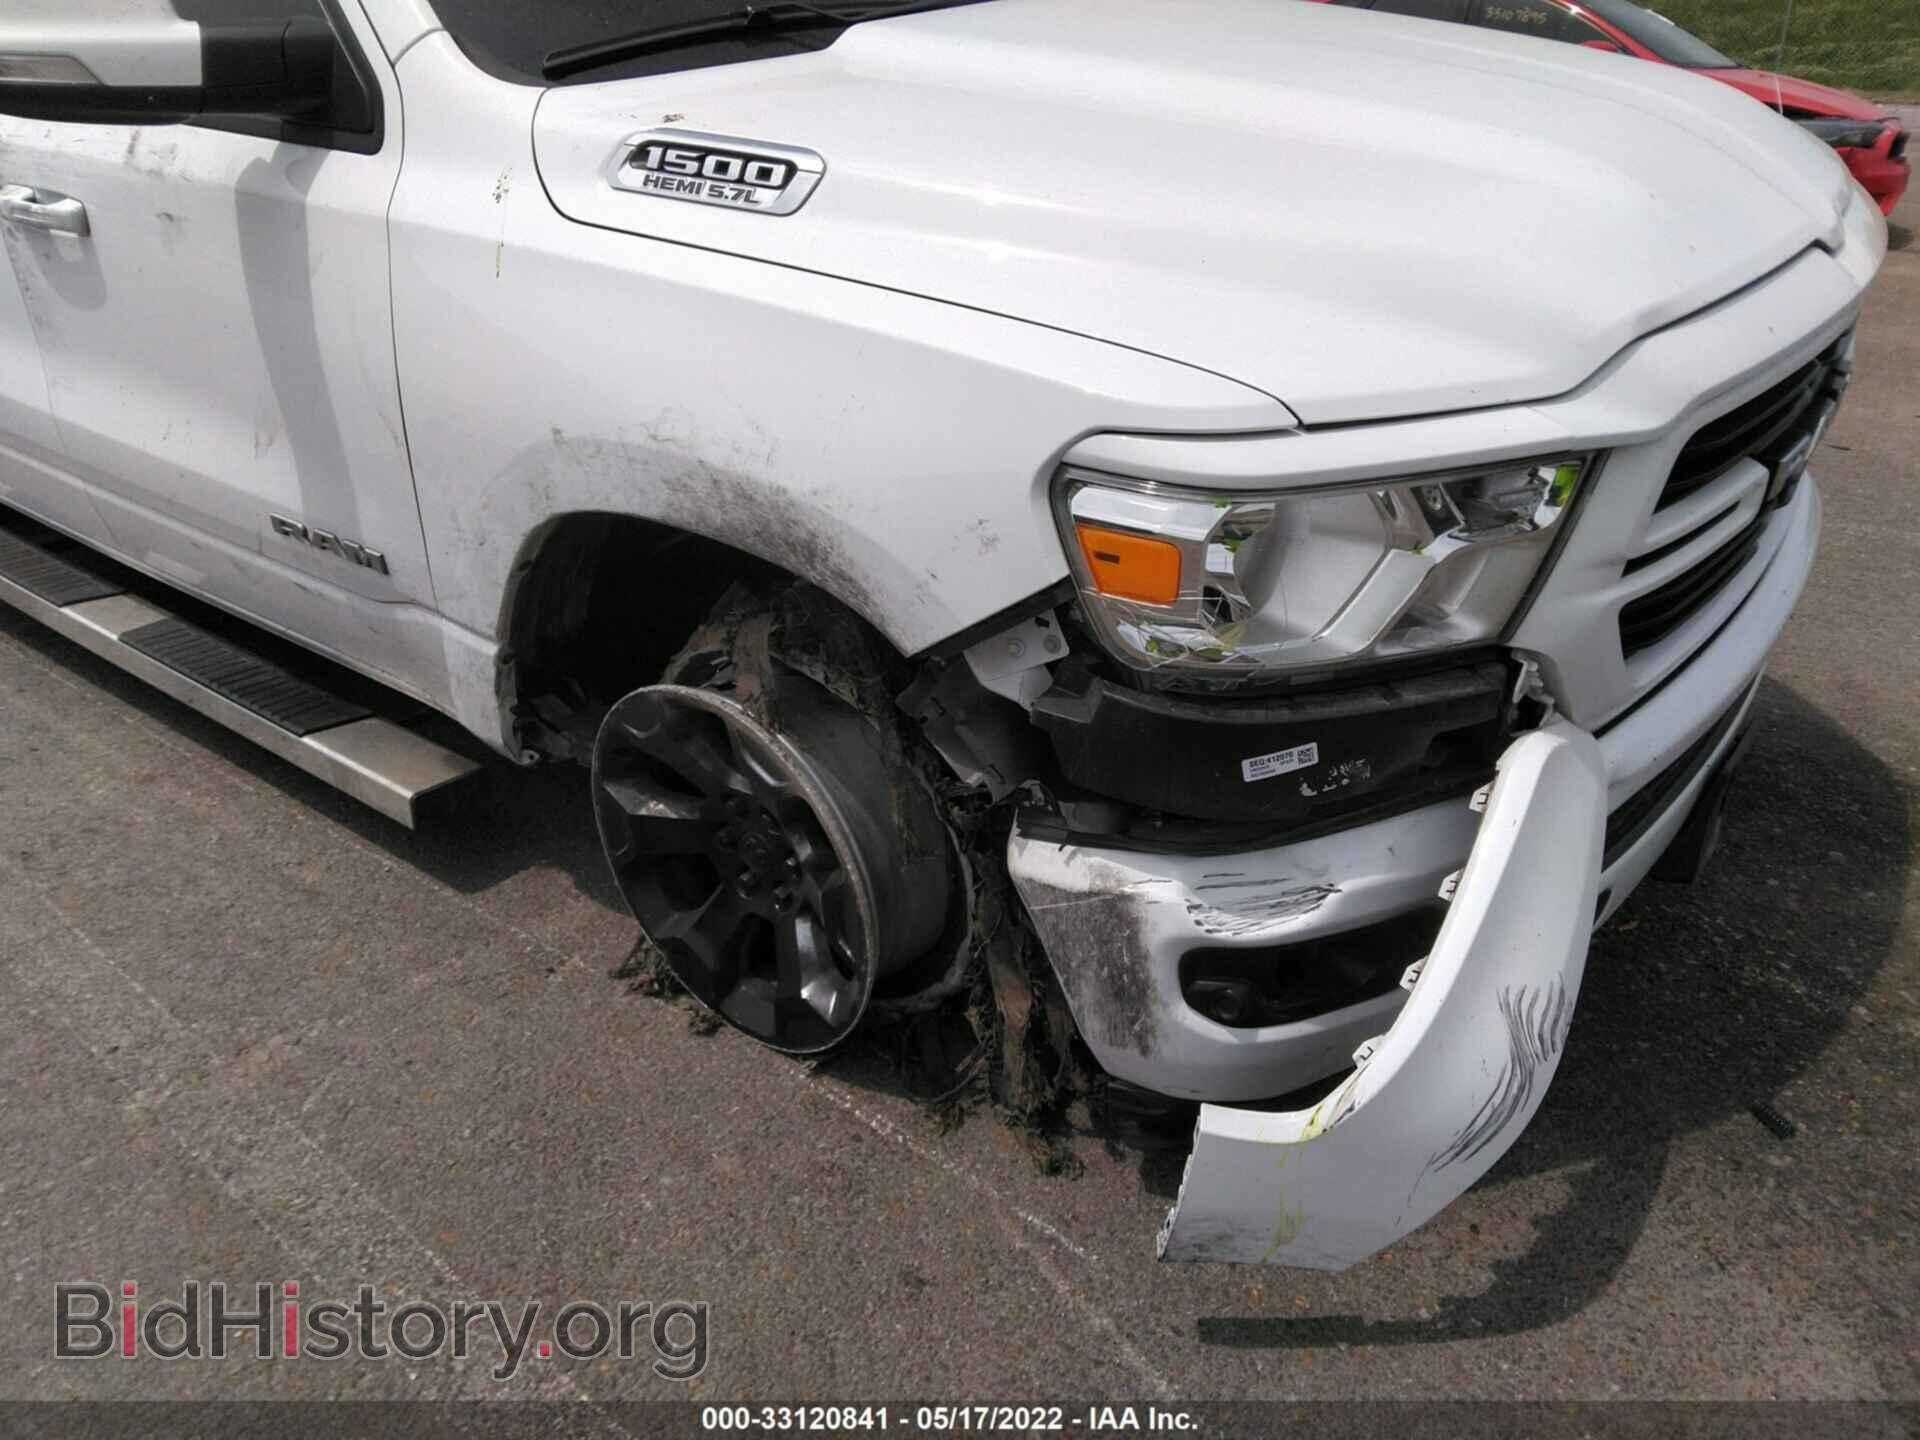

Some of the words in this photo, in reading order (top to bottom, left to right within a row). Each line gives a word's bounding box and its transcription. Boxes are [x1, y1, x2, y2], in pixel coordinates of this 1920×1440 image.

[645, 146, 787, 188] 1500
[643, 174, 702, 195] HEMI
[708, 183, 762, 204] 5.7L
[270, 512, 390, 575] RAM
